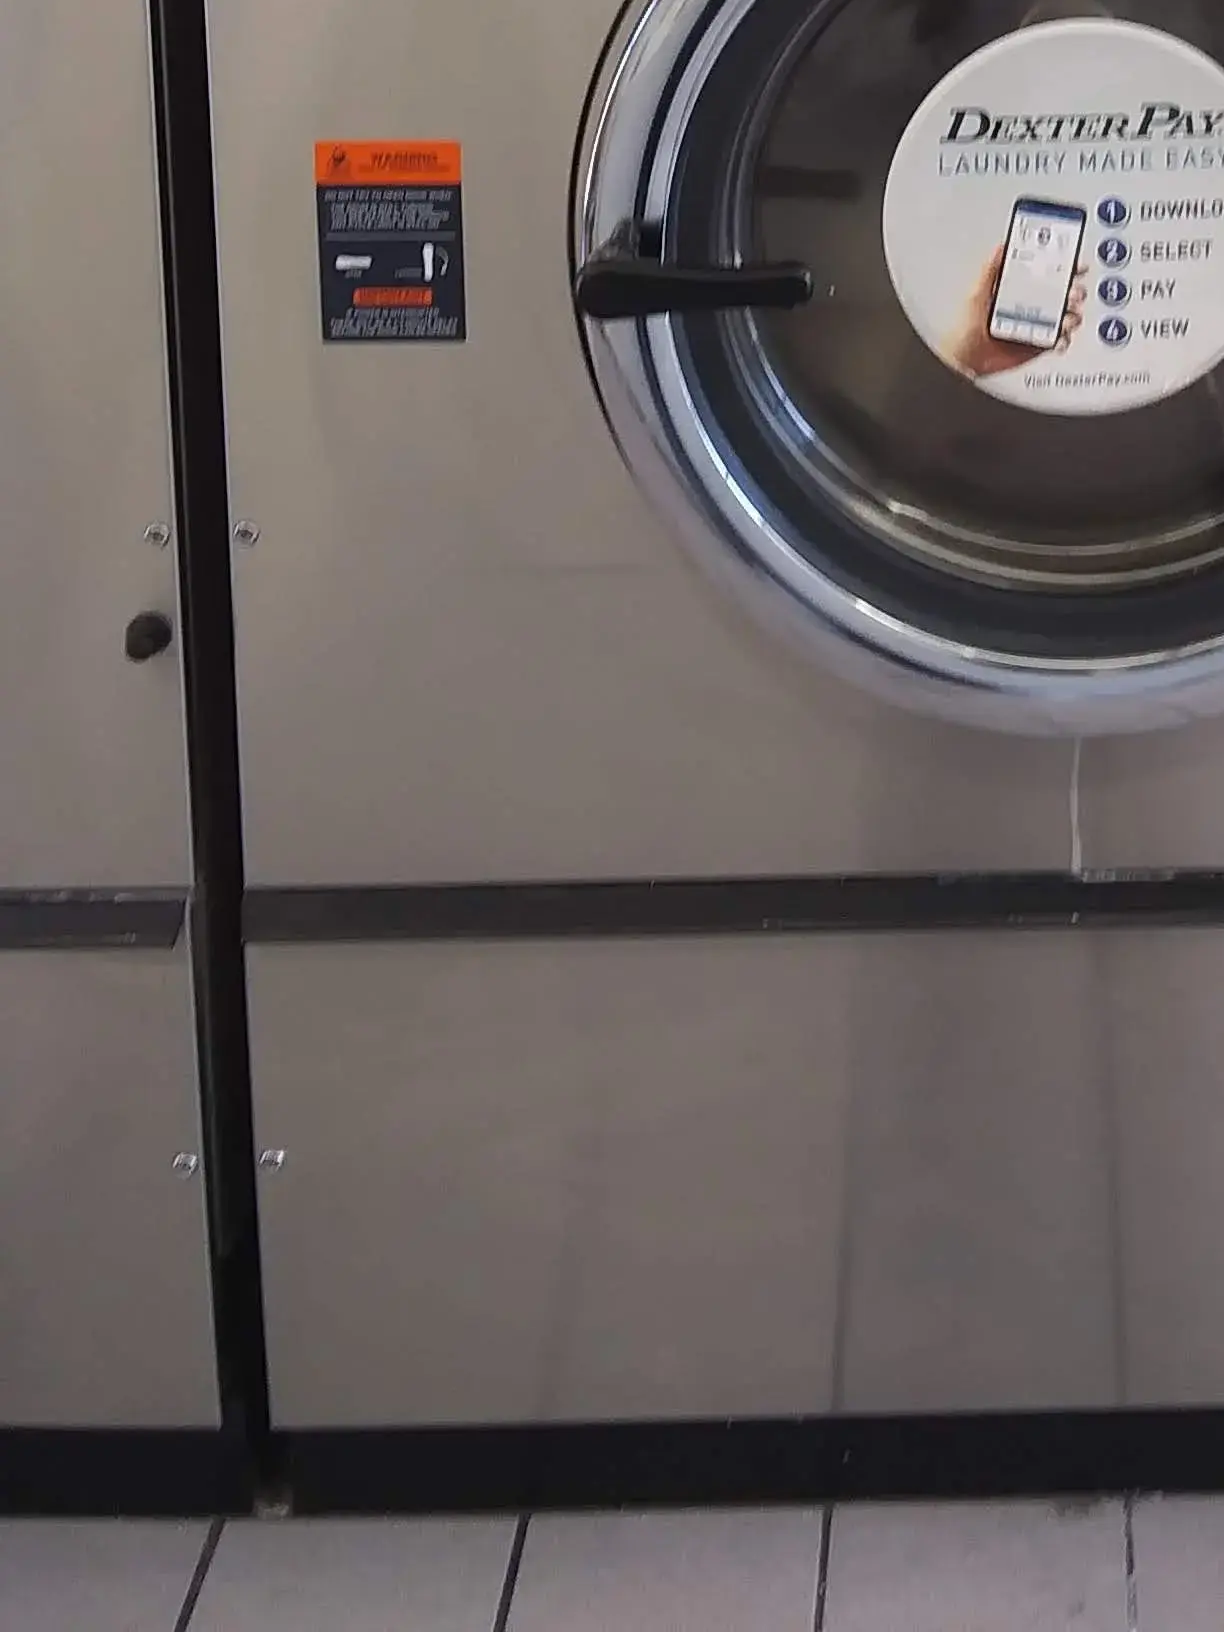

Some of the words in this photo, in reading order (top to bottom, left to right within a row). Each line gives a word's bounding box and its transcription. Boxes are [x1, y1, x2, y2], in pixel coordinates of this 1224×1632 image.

[939, 149, 1066, 176] LAUNDRY
[1078, 146, 1152, 174] MADE
[1139, 239, 1212, 262] SELECT
[1140, 278, 1176, 300] PAY
[1139, 317, 1190, 340] VIEW
